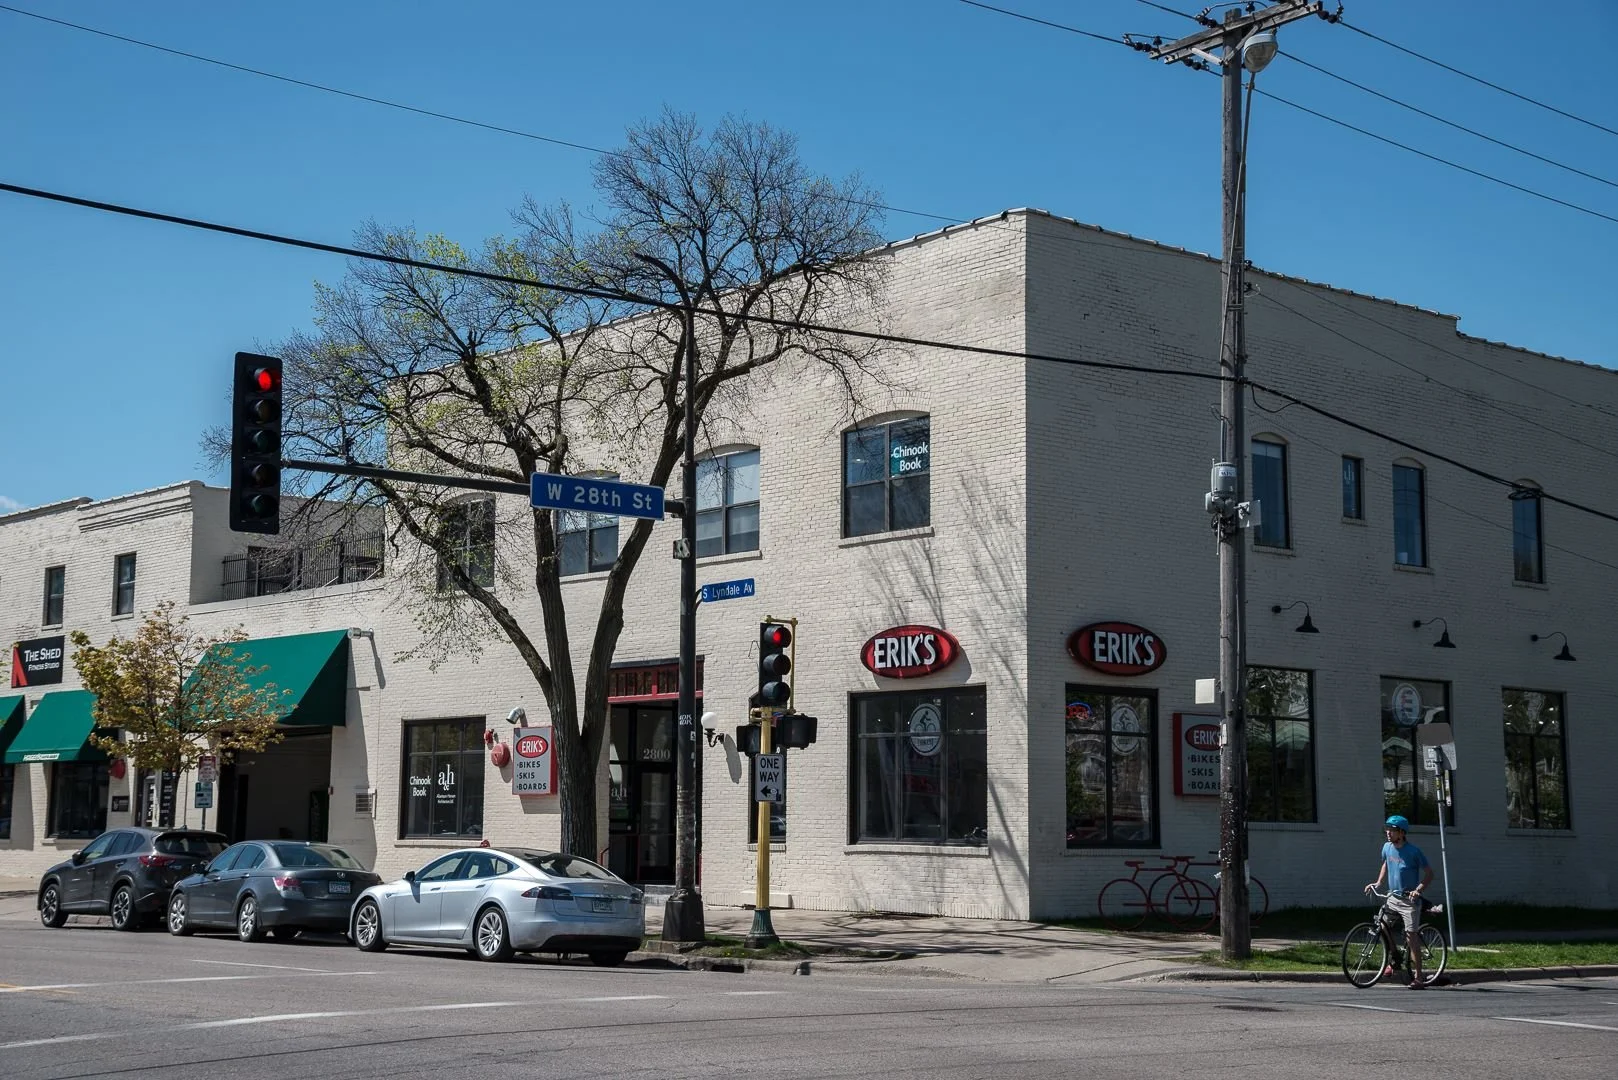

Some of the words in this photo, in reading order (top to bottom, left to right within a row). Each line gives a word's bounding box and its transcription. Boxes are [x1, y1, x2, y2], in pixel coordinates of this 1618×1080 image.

[892, 441, 928, 458] Chinook
[900, 456, 922, 472] Book
[547, 483, 562, 501] W
[574, 486, 621, 508] 28th
[632, 492, 652, 511] St
[702, 587, 708, 600] S
[712, 585, 740, 600] Lyndale
[743, 582, 753, 595] Av
[874, 633, 936, 669] ERIK'S
[1094, 631, 1155, 666] ERIK'S
[521, 740, 543, 753] ERIK'S
[643, 748, 671, 760] 2800
[1191, 754, 1221, 763] BIKES
[760, 757, 780, 769] ONE
[519, 772, 535, 780] SKIS
[759, 771, 780, 783] WAY
[1191, 768, 1214, 777] SKIS
[410, 775, 432, 785] Chinook
[1191, 781, 1221, 790] BOAR
[412, 786, 427, 797] Book
[518, 783, 547, 791] BOARDS
